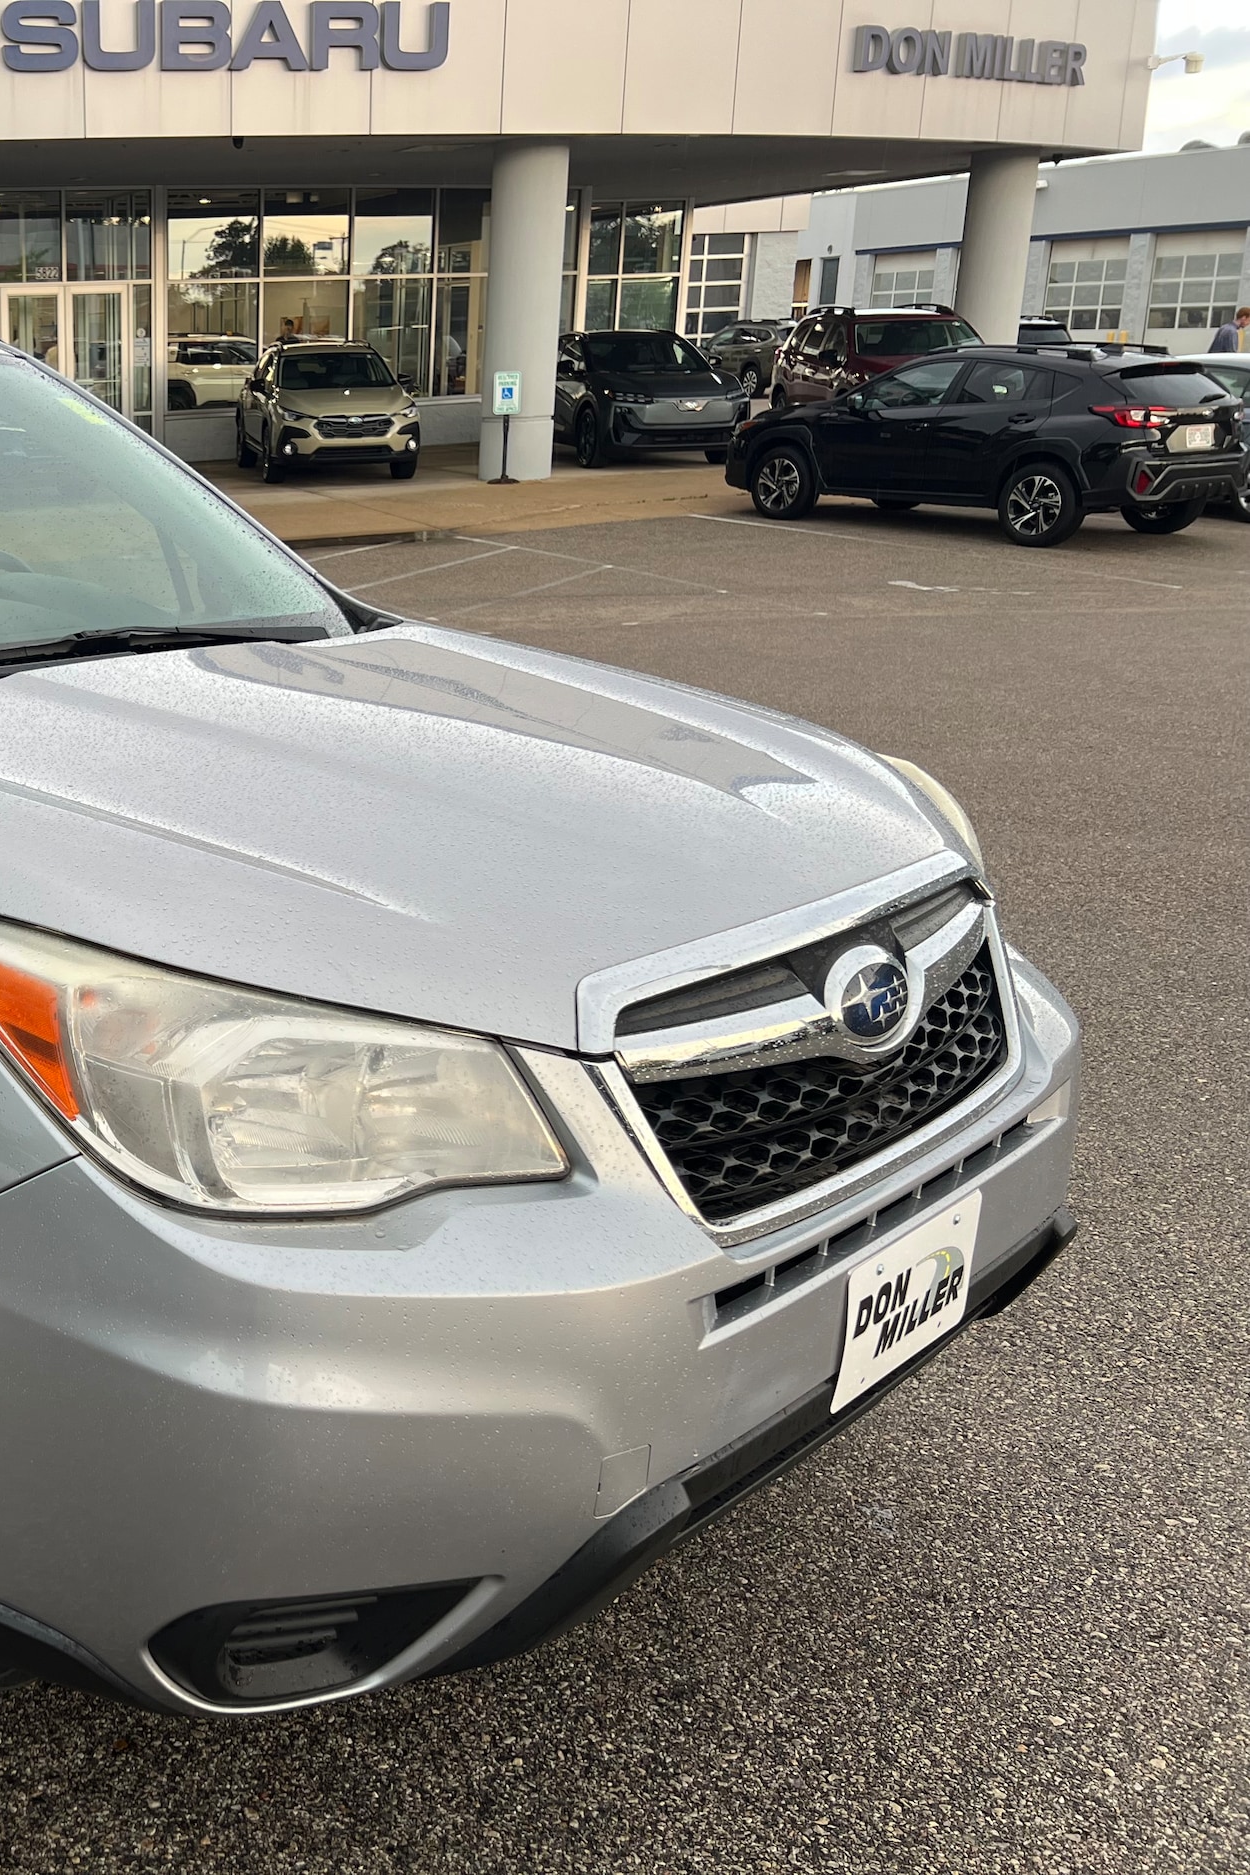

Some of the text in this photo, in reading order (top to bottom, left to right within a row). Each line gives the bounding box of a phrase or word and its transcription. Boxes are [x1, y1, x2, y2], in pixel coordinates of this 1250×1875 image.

[0, 0, 451, 71] SUBARU
[853, 25, 1087, 86] DON MILLER
[852, 1267, 912, 1340] DON
[873, 1265, 964, 1360] MILLER
